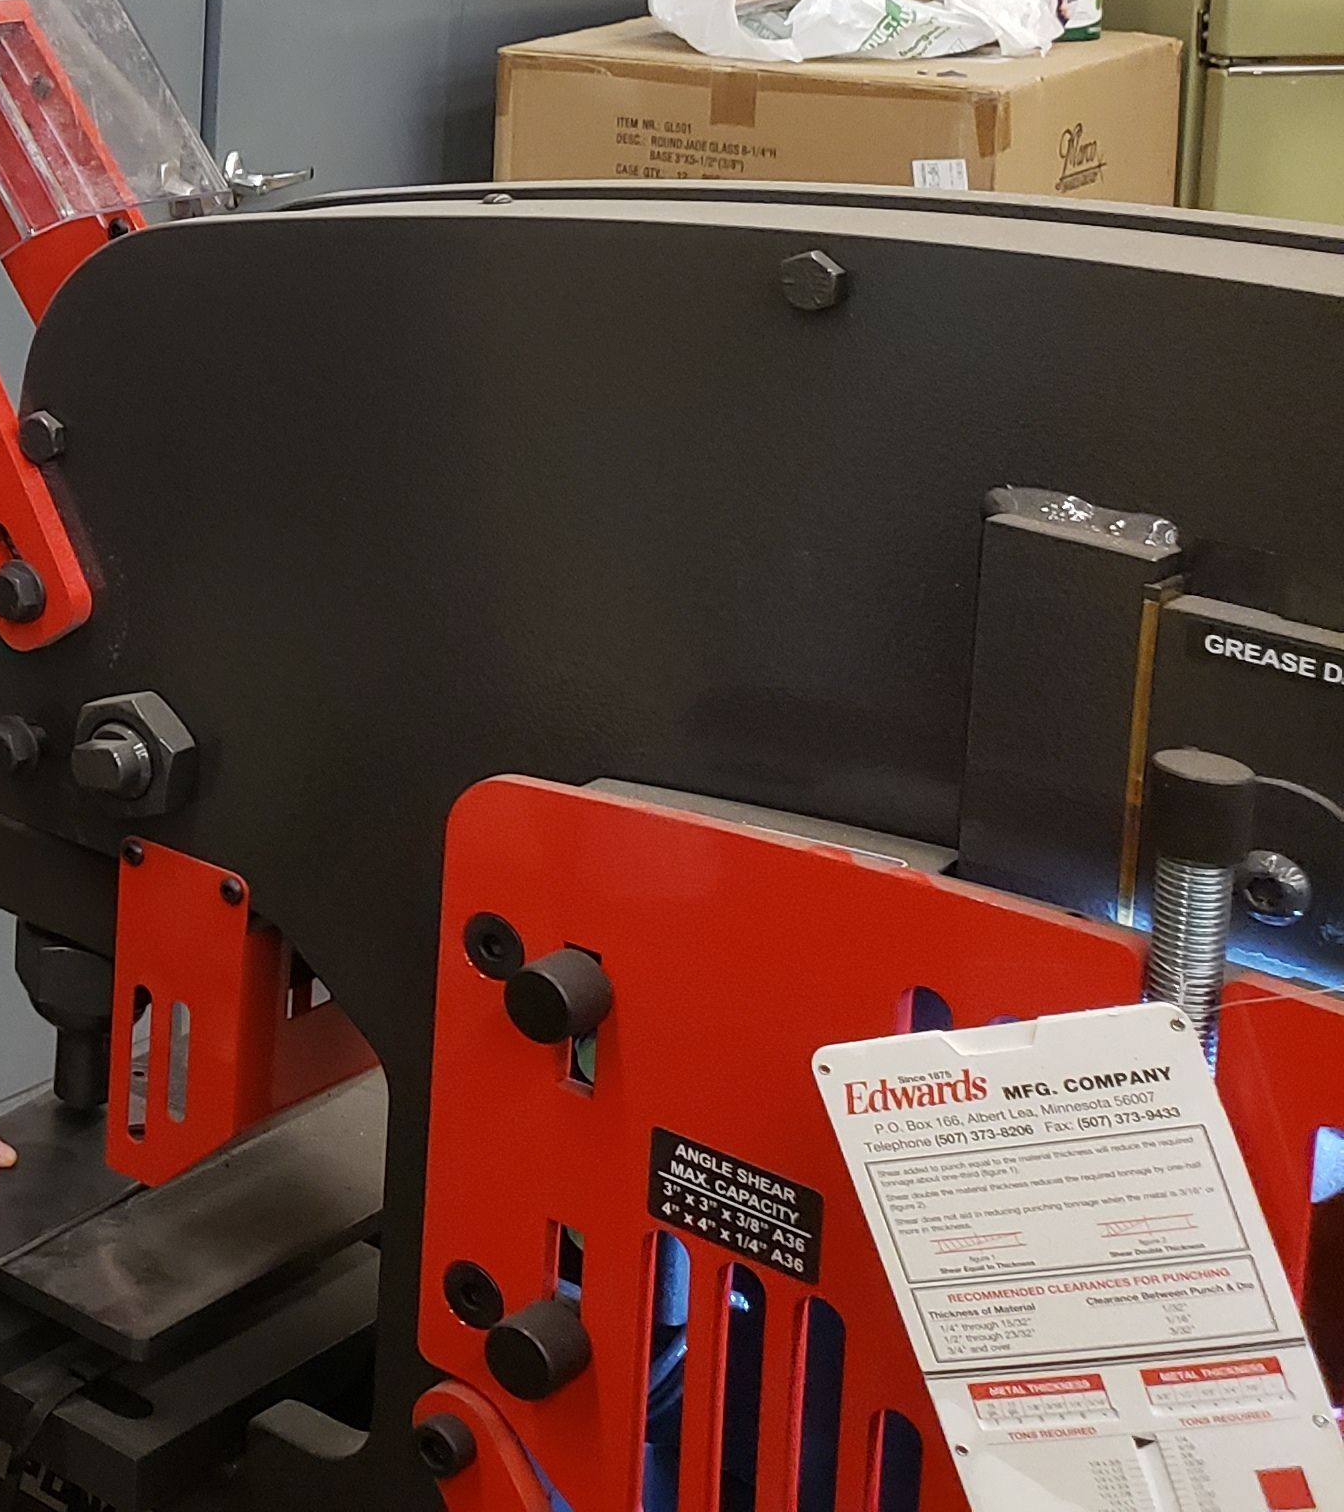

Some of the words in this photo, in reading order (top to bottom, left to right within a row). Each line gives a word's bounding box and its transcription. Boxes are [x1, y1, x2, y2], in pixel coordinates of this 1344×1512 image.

[616, 117, 638, 129] ITEM
[650, 136, 683, 148] ROUND
[684, 138, 707, 151] JADE
[709, 142, 740, 155] GLASS
[649, 150, 673, 163] BASE
[616, 163, 639, 176] CASE
[1205, 634, 1317, 678] GREASE
[1324, 662, 1344, 685] D
[897, 1072, 926, 1084] Since
[927, 1070, 952, 1081] 1875
[844, 1068, 989, 1115] Edwards
[1001, 1082, 1059, 1101] MFG.
[1063, 1066, 1171, 1093] COMPANY
[874, 1121, 902, 1135] P.O.
[906, 1119, 933, 1132] Box
[936, 1115, 964, 1128] 166,
[967, 1109, 1006, 1124] Albert
[1009, 1108, 1038, 1120] Lea,
[1040, 1098, 1112, 1116] Minnesota
[1114, 1091, 1155, 1107] 56007
[864, 1137, 932, 1154] Telephone
[934, 1132, 968, 1148] (507)
[971, 1124, 1034, 1143] 373-8206
[1044, 1120, 1074, 1134] Fax:
[1077, 1115, 1112, 1132] (507)
[1115, 1106, 1181, 1125] 373-9433
[903, 1166, 928, 1175] added
[941, 1162, 966, 1173] punch
[969, 1159, 991, 1170] equal
[992, 1158, 1001, 1166] to
[1003, 1156, 1016, 1165] the
[1018, 1152, 1052, 1163] material
[1053, 1147, 1093, 1159] thickness
[1095, 1145, 1109, 1154] will
[1111, 1142, 1140, 1152] reduce
[1141, 1140, 1156, 1149] the
[1158, 1136, 1194, 1148] required
[675, 1143, 733, 1178] ANGLE
[736, 1168, 796, 1204] SHEAR
[880, 1178, 914, 1188] tonnage
[915, 1175, 940, 1185] about
[942, 1171, 979, 1182] one-third
[911, 1189, 939, 1200] double
[941, 1188, 954, 1197] the
[955, 1184, 988, 1195] material
[990, 1180, 1028, 1192] thickness
[1030, 1176, 1064, 1187] reduces
[1065, 1173, 1079, 1183] the
[1080, 1171, 1116, 1182] required
[1117, 1168, 1152, 1179] tonnage
[1153, 1166, 1164, 1175] by
[670, 1160, 711, 1189] MAX.
[714, 1179, 800, 1225] CAPACITY
[943, 1213, 957, 1222] not
[959, 1211, 972, 1220] aid
[974, 1210, 982, 1218] in
[984, 1206, 1021, 1218] reducing
[1023, 1201, 1062, 1215] punching
[1063, 1198, 1099, 1210] tonnage
[1100, 1195, 1126, 1206] when
[1126, 1193, 1141, 1202] the
[1143, 1191, 1167, 1201] metal
[684, 1192, 696, 1207] x
[720, 1207, 732, 1222] x
[771, 1228, 806, 1253] A36
[683, 1211, 694, 1226] x
[719, 1227, 731, 1242] x
[770, 1248, 805, 1273] A36
[963, 1264, 985, 1274] Equal
[996, 1259, 1036, 1269] Thickness
[947, 1287, 1045, 1303] RECOMMENDED
[1048, 1277, 1131, 1294] CLEARANCES
[1133, 1274, 1161, 1286] FOR
[1162, 1267, 1231, 1283] PUNCHING
[927, 1308, 979, 1320] Thickness
[981, 1306, 992, 1315] of
[994, 1303, 1036, 1314] Material
[1086, 1293, 1139, 1306] Clearance
[1141, 1289, 1188, 1300] Between
[1190, 1284, 1224, 1295] Punch
[1237, 1281, 1255, 1290] Die
[961, 1320, 999, 1332] through
[965, 1331, 1002, 1343] through
[969, 1344, 989, 1353] and
[991, 1343, 1011, 1352] over
[1158, 1370, 1198, 1383] METAL
[989, 1385, 1026, 1397] METAL
[1179, 1416, 1211, 1427] TONS
[1212, 1409, 1272, 1424] REQUIRED
[1008, 1430, 1038, 1441] TONS
[1040, 1426, 1097, 1439] REQUIRED
